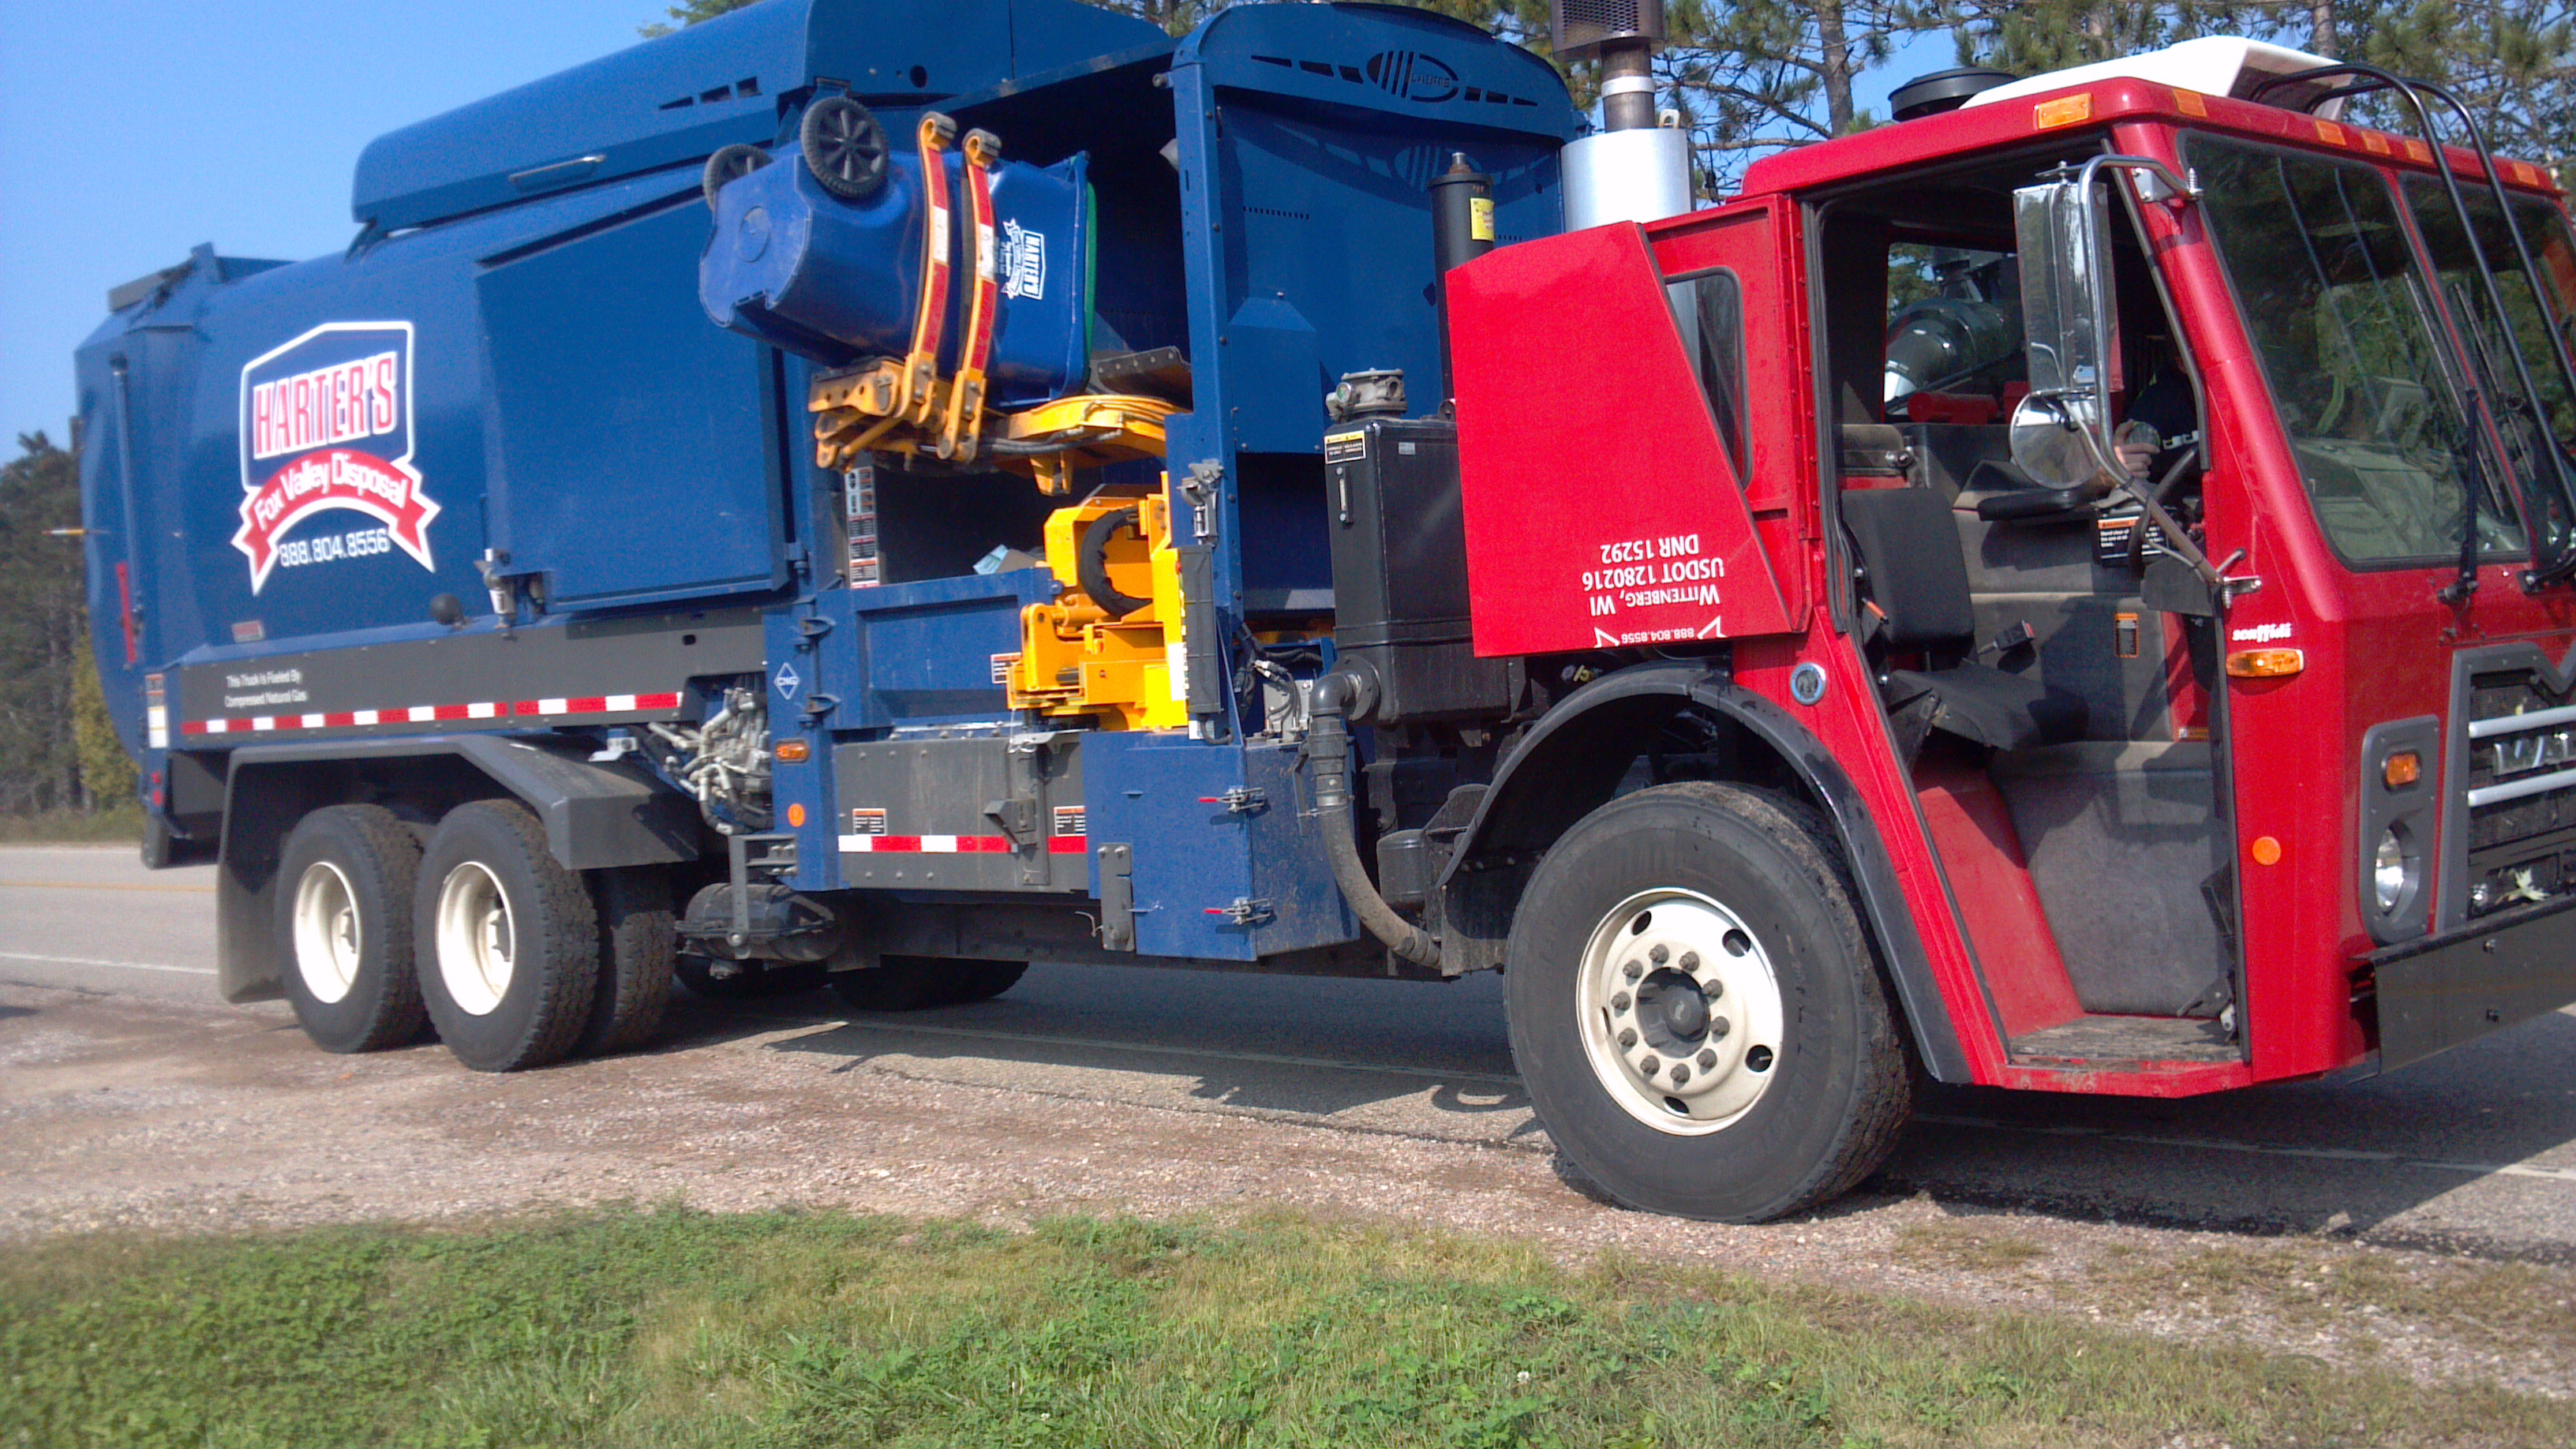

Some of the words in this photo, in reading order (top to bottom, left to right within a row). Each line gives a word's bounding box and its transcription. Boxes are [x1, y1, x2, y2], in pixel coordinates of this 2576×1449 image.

[1412, 73, 1451, 88] LABRIE
[1024, 235, 1041, 295] HARTER'S
[253, 351, 398, 460] HARTER'S
[253, 492, 283, 530] Fox
[280, 460, 331, 502] Valley
[331, 453, 406, 509] Disposal
[279, 529, 390, 567] 888.804.8556
[1600, 539, 1655, 564] 15292
[1658, 534, 1699, 558] DNR
[1582, 564, 1657, 592] 1280216
[1661, 557, 1725, 584] USDOT
[1589, 595, 1616, 616] WI
[1620, 627, 1695, 644] 888.804.8556
[226, 675, 240, 688] This
[240, 673, 260, 687] Truck
[267, 671, 290, 684] Fueled
[290, 668, 301, 684] By
[224, 693, 265, 709] Compressed
[265, 691, 291, 704] Natural
[291, 689, 308, 702] Gas
